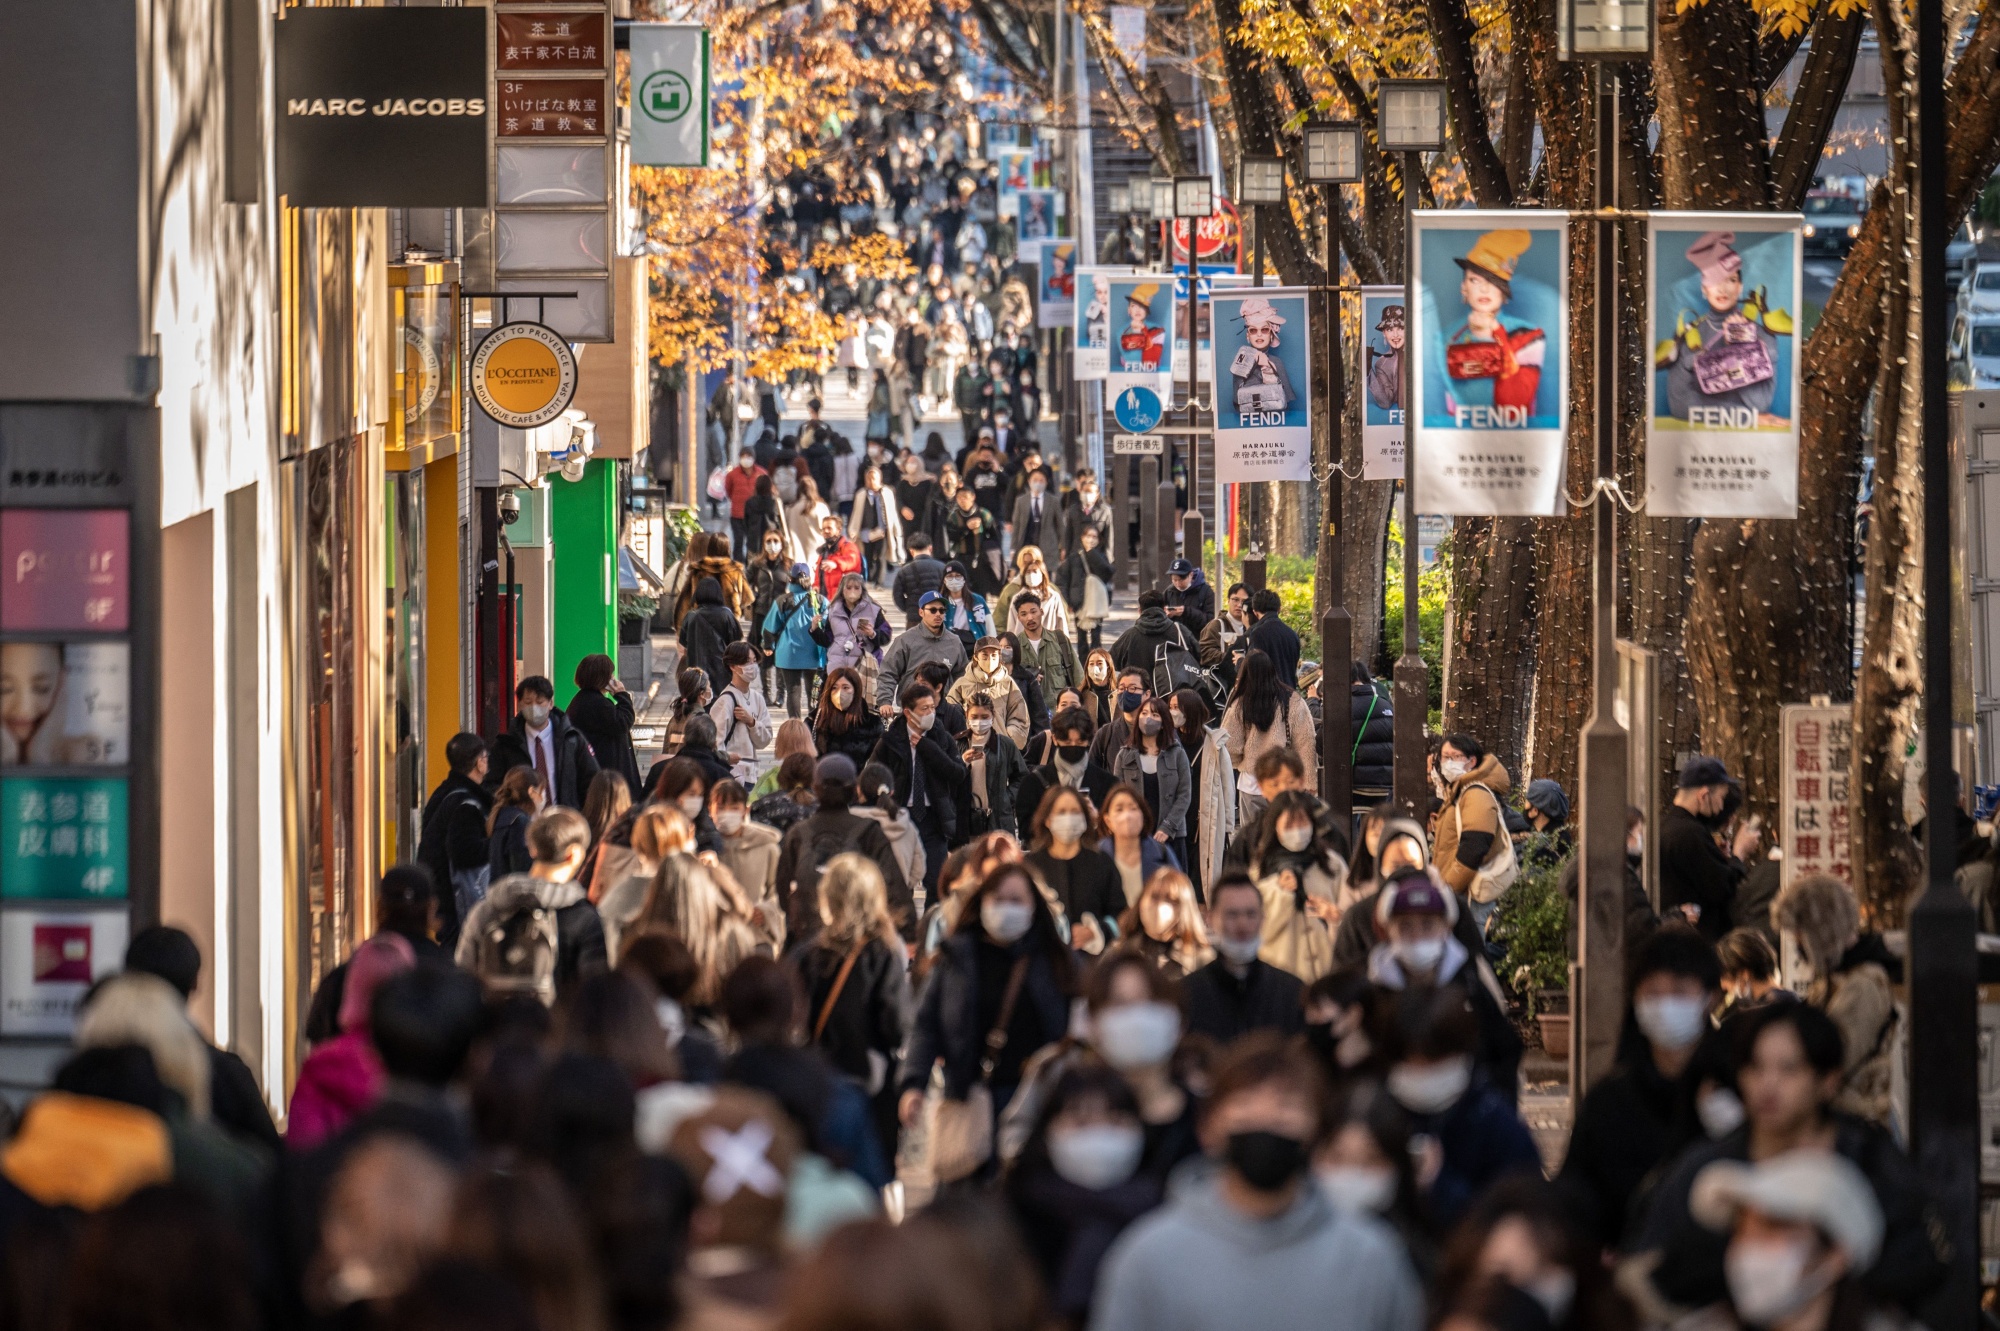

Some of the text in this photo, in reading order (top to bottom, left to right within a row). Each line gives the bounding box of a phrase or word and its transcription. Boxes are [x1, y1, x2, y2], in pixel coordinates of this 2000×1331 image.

[531, 22, 570, 36] 茶道
[505, 45, 597, 60] 表千家不白流
[504, 82, 524, 94] 3F
[287, 98, 486, 117] MARC JACOBS
[504, 98, 597, 112] いけばな教室
[505, 117, 597, 131] 茶道教室
[475, 327, 570, 370] JOURNEY TO PROVENCE
[1124, 361, 1158, 373] FENDI
[476, 384, 510, 421] BOUTIQUE
[511, 415, 534, 424] CAFÉ
[543, 398, 562, 417] PETIT
[559, 381, 570, 397] SPA
[1240, 411, 1286, 427] FENDI
[1455, 404, 1528, 429] FENDI
[1687, 405, 1760, 430] FENDI
[1116, 440, 1161, 451] 歩行者優先
[19, 789, 111, 824] 表参道
[17, 825, 110, 858] 皮膚科
[80, 865, 116, 894] 4F
